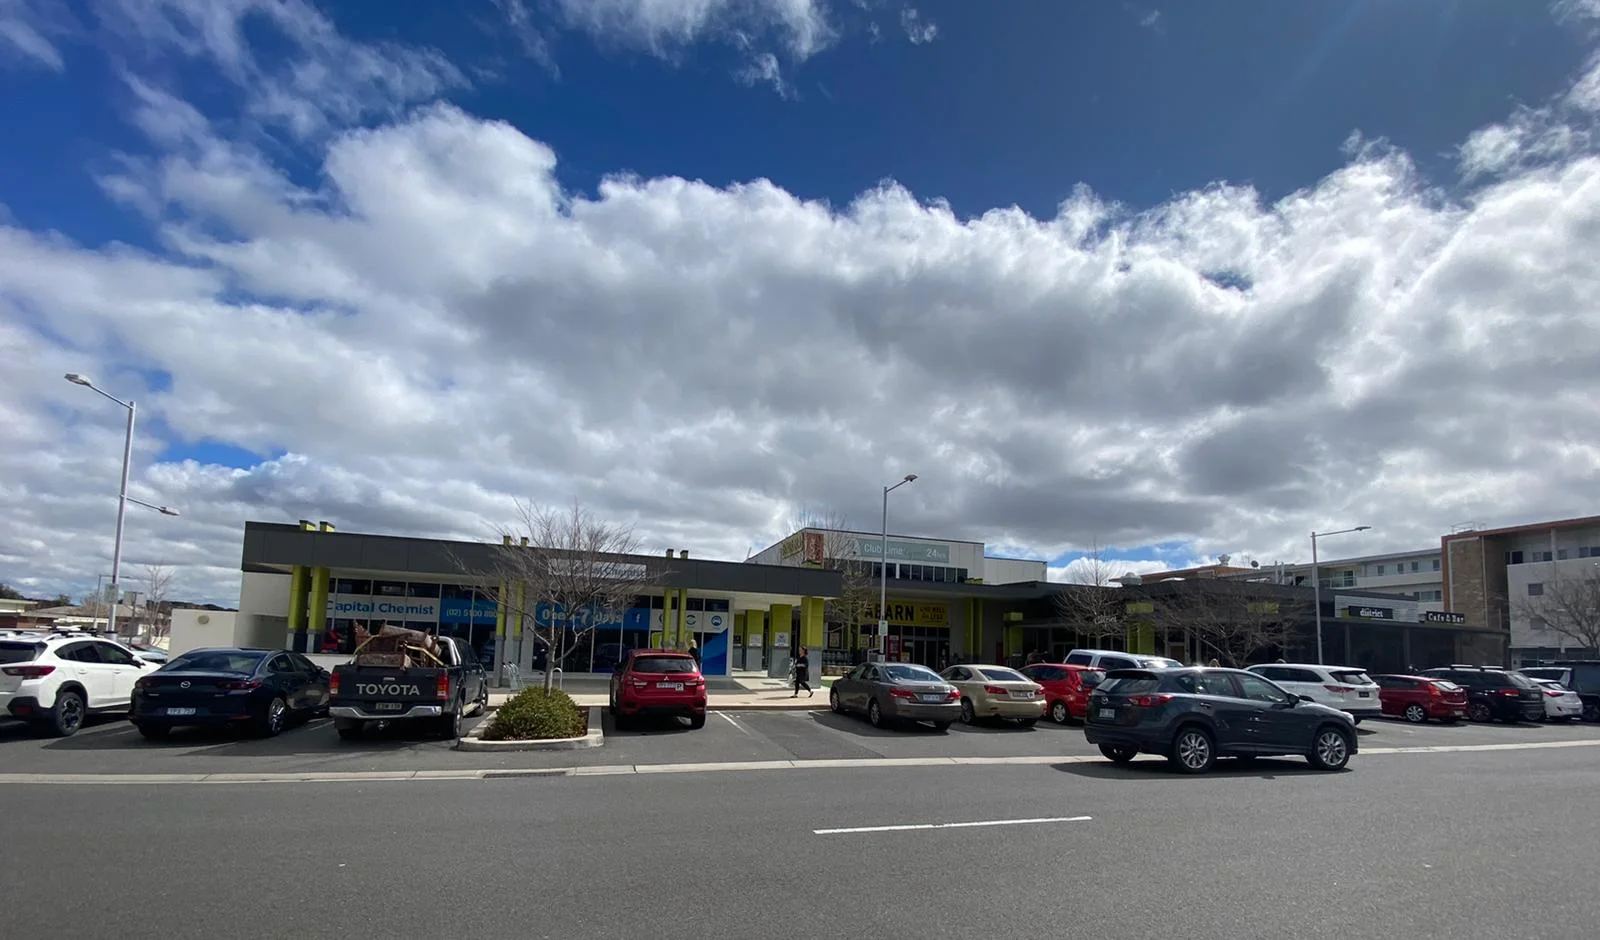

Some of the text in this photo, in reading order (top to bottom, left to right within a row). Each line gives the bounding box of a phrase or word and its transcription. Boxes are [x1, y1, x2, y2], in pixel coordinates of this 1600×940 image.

[864, 543, 882, 553] Club
[327, 600, 434, 615] Capital Chemist
[356, 683, 420, 696] TOYOTA
